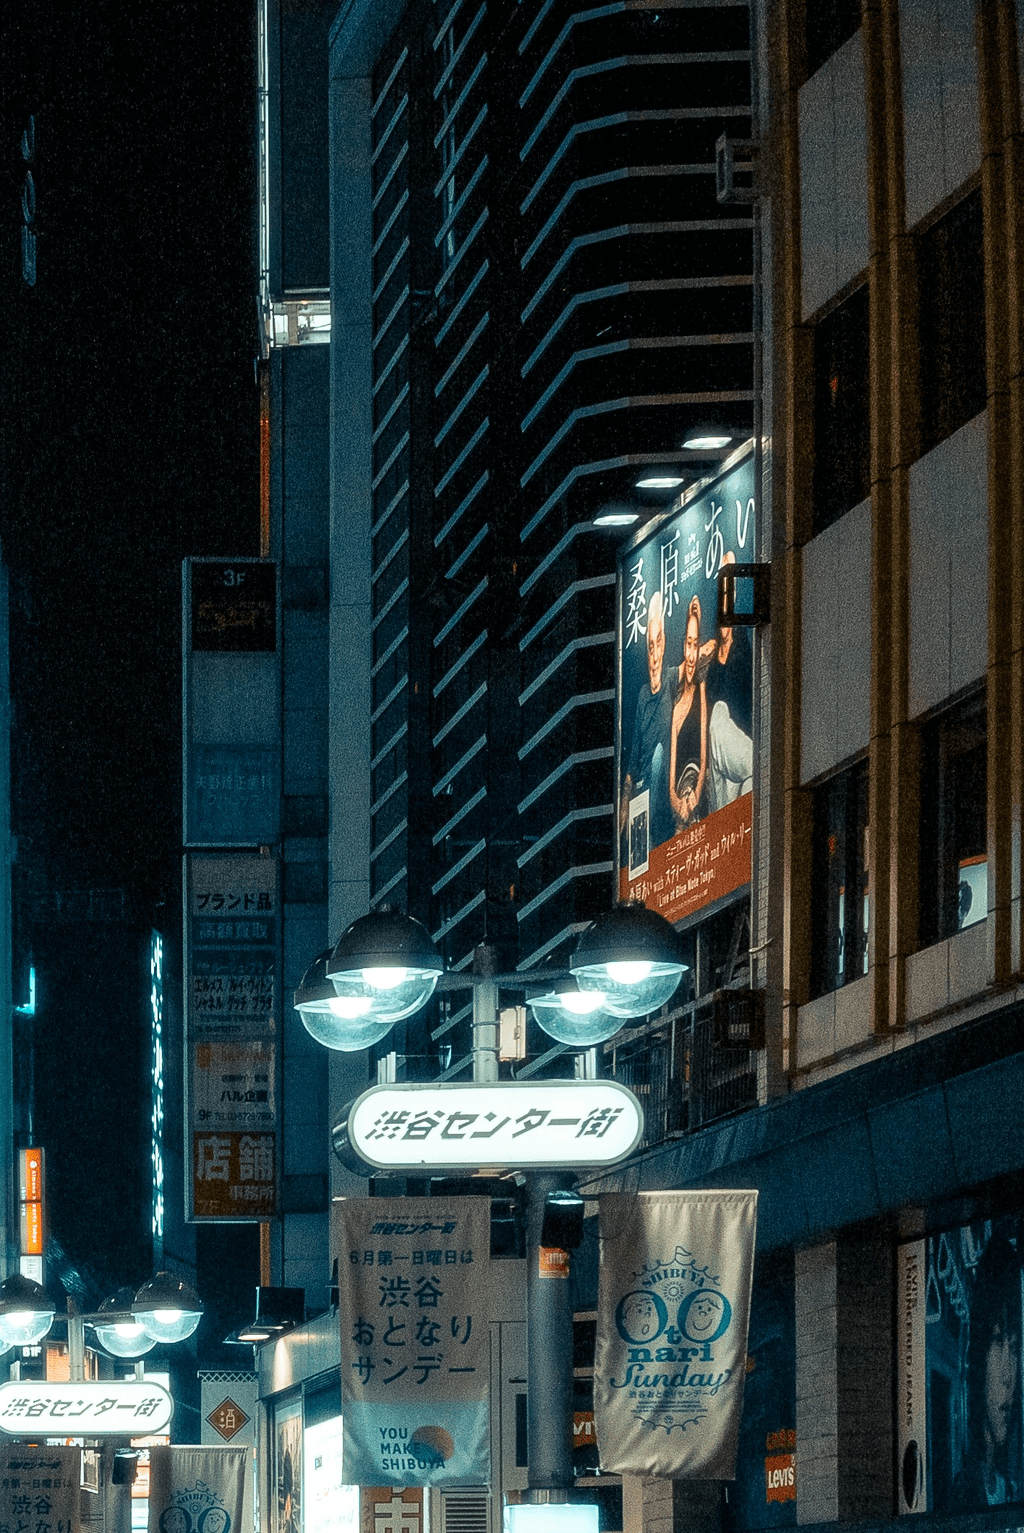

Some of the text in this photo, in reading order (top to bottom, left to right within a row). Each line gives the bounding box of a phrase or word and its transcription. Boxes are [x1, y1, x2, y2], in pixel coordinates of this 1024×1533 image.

[223, 569, 246, 587] 3F
[197, 892, 272, 910] ブランド品
[363, 1107, 625, 1141] 渋谷センター街
[196, 1135, 274, 1182] 店舗
[369, 1221, 457, 1236] 渋谷センター街
[349, 1249, 474, 1267] 6月第一日曜日は
[642, 1268, 707, 1289] SHIBUYA
[379, 1275, 444, 1309] 渋谷
[352, 1315, 473, 1347] おとなり
[627, 1342, 715, 1363] nari
[352, 1352, 476, 1386] サンデー
[610, 1364, 732, 1396] Sunday
[1, 1397, 163, 1418] 渋谷センター街
[379, 1428, 409, 1440] YOU
[381, 1457, 446, 1471] SHIBUYA
[11, 1494, 53, 1516] 渋谷
